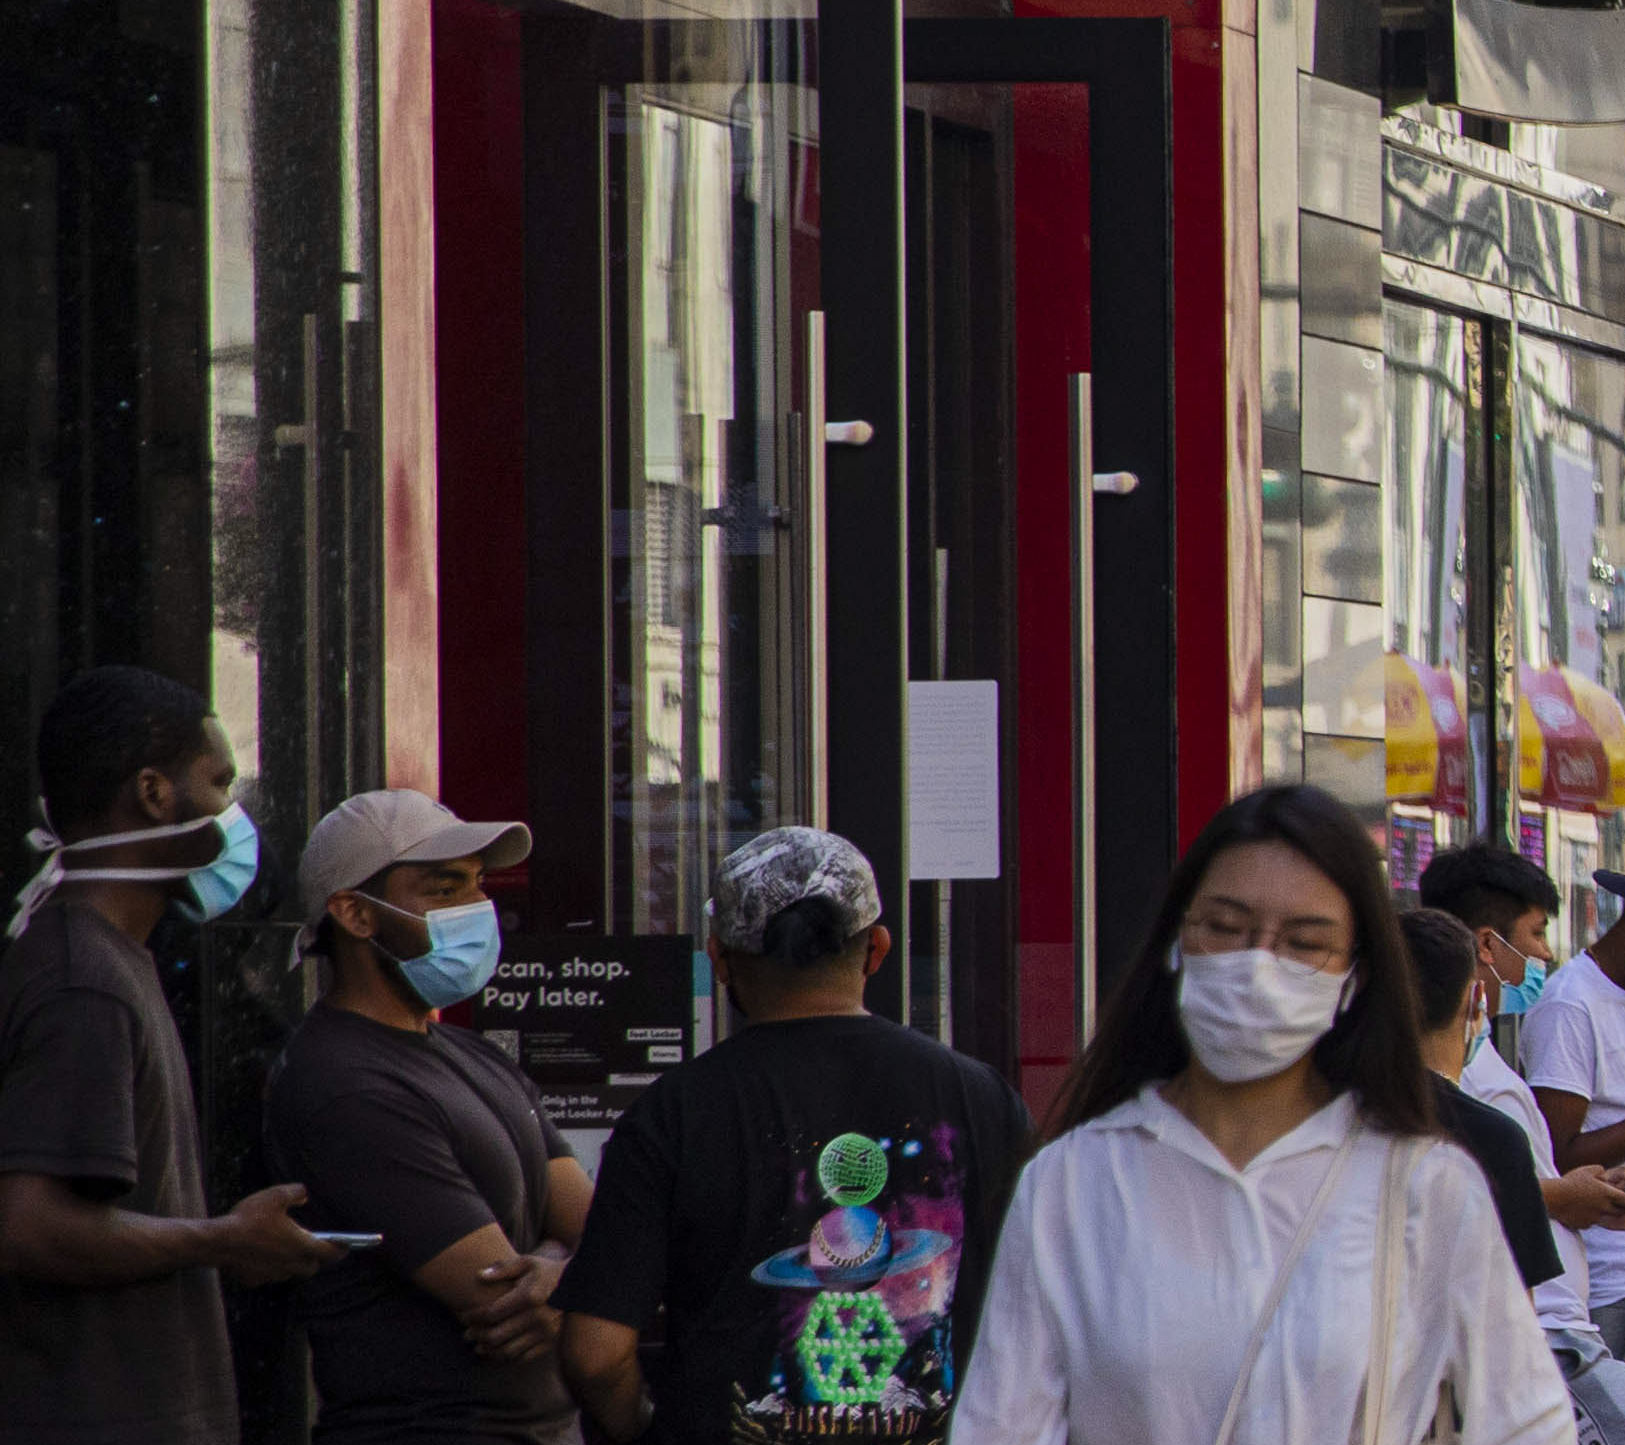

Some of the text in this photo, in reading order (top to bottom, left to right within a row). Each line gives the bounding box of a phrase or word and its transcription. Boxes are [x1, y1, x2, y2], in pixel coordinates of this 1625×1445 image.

[498, 956, 631, 981] can, shop.
[483, 986, 604, 1010] Pay later.
